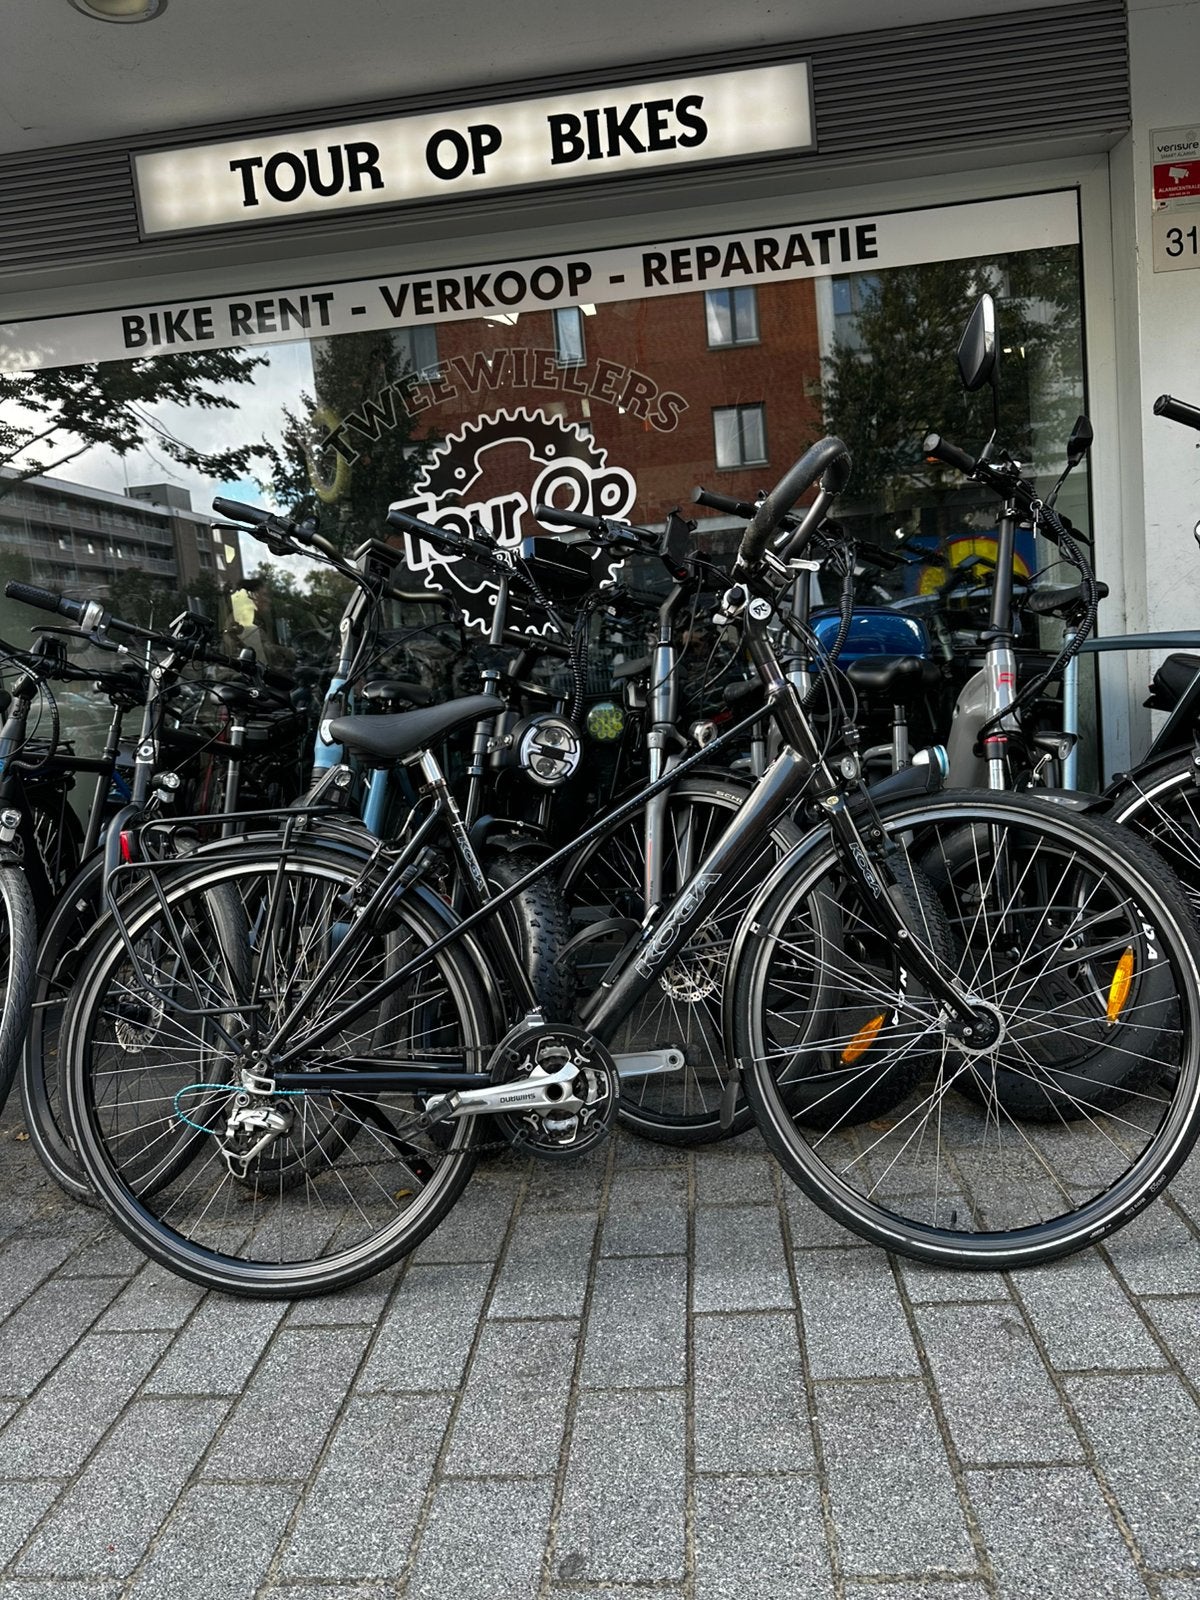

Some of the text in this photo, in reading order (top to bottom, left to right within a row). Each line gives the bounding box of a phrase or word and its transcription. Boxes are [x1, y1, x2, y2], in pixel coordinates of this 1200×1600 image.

[230, 95, 708, 206] TOUR OP BIKES
[1157, 140, 1200, 154] verisure
[1165, 226, 1198, 257] 31
[121, 306, 215, 349] BIKE
[230, 292, 334, 337] RENT
[379, 261, 592, 318] VERKOOP
[642, 223, 878, 287] REPARATIE
[320, 347, 690, 466] TWEEWIELERS
[456, 836, 485, 892] KOGA
[849, 842, 881, 899] KOGA
[634, 873, 722, 979] KOGA
[500, 1093, 536, 1104] SHIMANO
